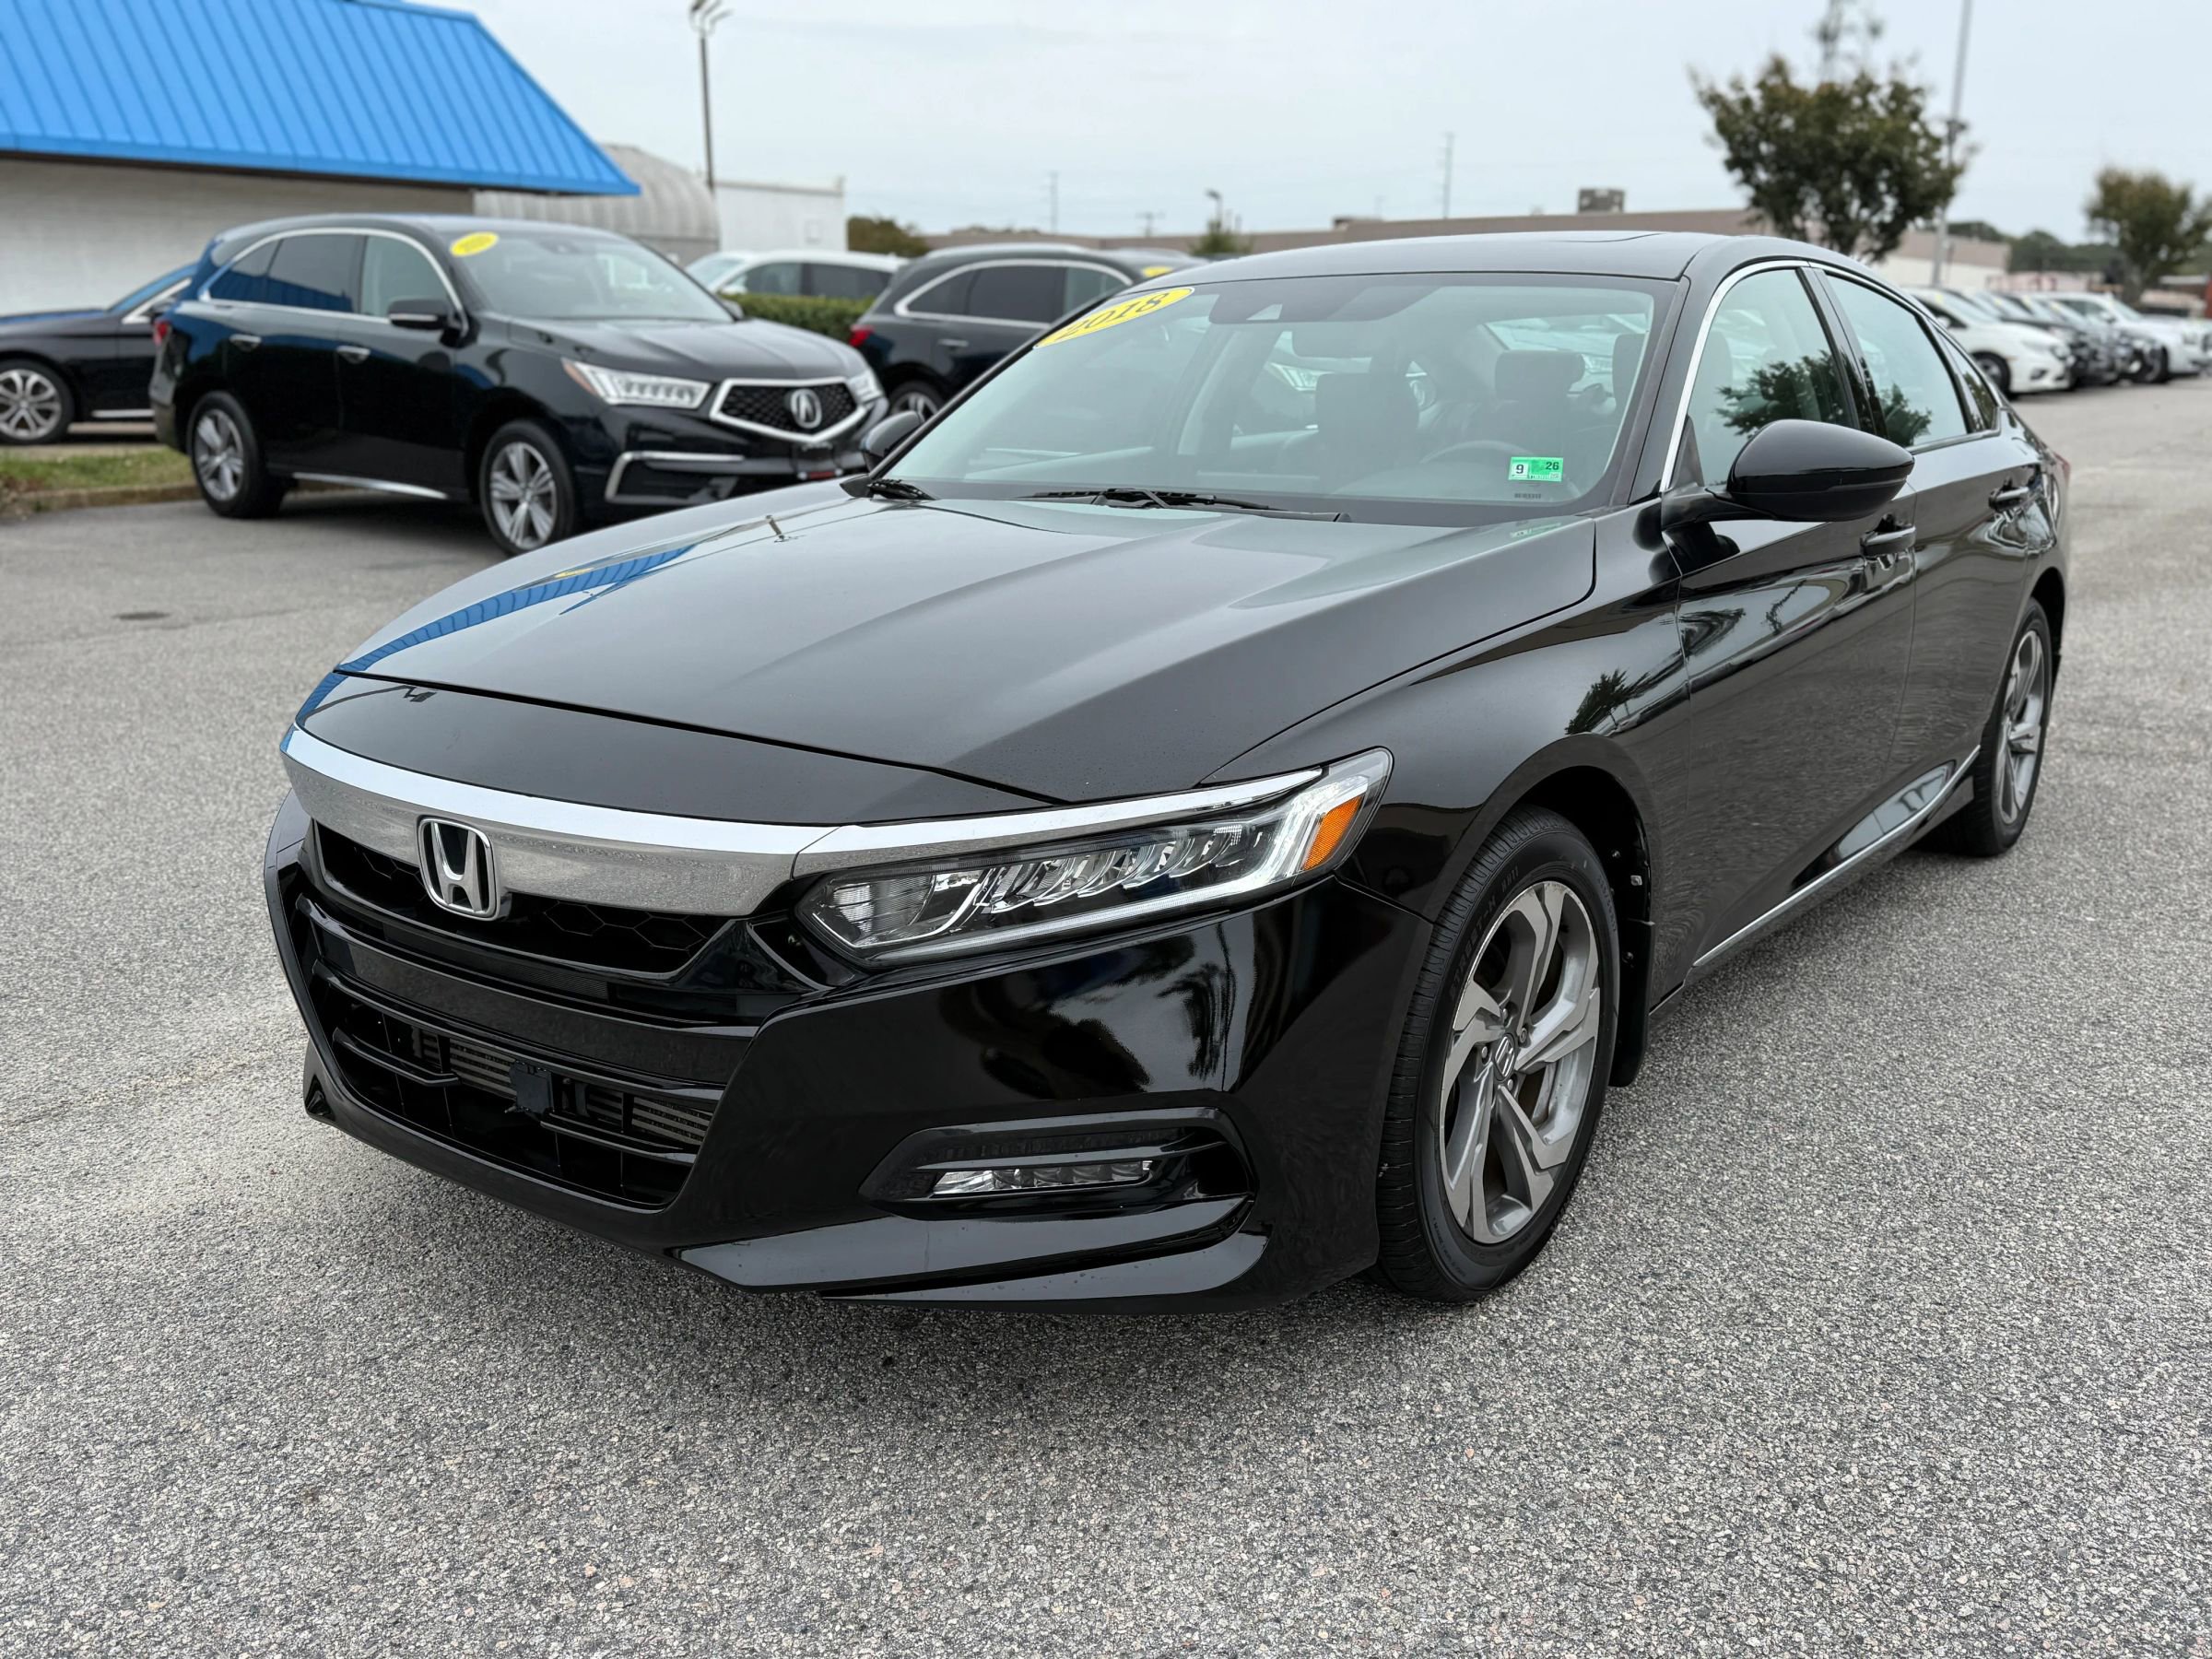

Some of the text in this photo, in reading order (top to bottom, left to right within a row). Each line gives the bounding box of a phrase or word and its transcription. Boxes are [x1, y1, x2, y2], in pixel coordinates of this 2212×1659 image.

[1054, 292, 1171, 341] 2018
[1515, 461, 1559, 475] 9 26
